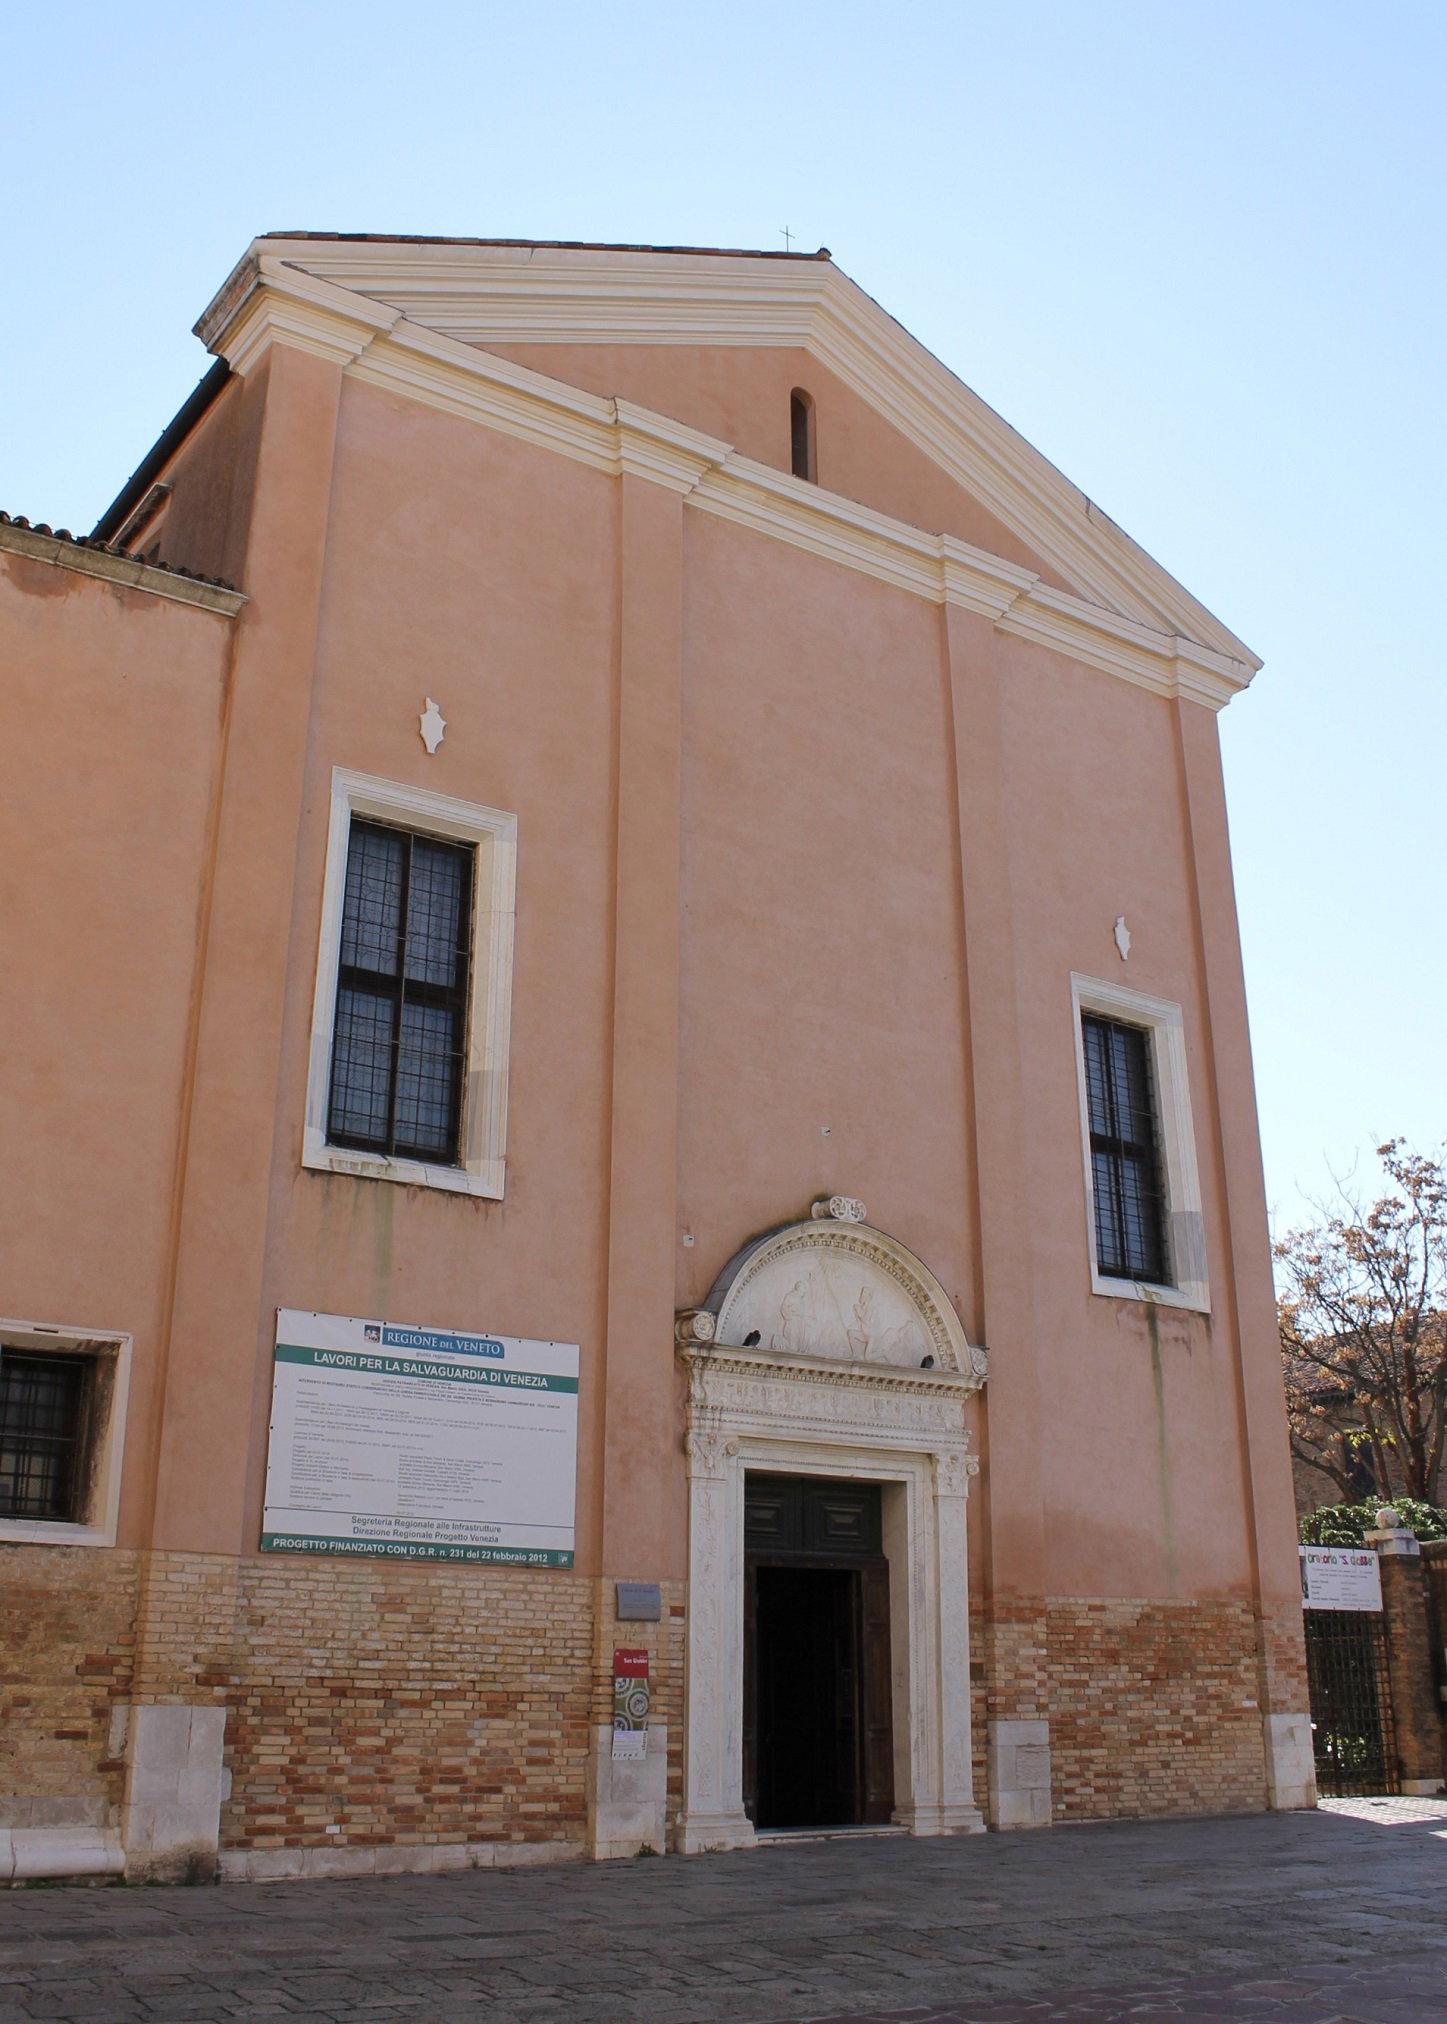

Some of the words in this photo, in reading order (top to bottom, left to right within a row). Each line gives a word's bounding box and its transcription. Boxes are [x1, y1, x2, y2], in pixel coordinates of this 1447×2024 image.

[386, 1332, 438, 1348] REGIONE
[456, 1340, 500, 1355] VENETO
[314, 1351, 356, 1366] LAVORI
[359, 1358, 382, 1369] PER
[385, 1361, 400, 1372] LA
[402, 1362, 488, 1381] SALVAGUARDIA
[490, 1372, 500, 1383] DI
[503, 1373, 548, 1388] VENEZIA
[351, 1515, 392, 1527] Segreteria
[394, 1518, 434, 1530] Regionale
[436, 1521, 450, 1530] alle
[452, 1522, 501, 1533] Infrastrutture
[352, 1526, 391, 1536] Direzione
[392, 1529, 433, 1539] Regionale
[434, 1531, 468, 1543] Progetto
[470, 1534, 499, 1543] Venezia
[273, 1537, 327, 1550] PROGETTO
[329, 1541, 385, 1553] FINANZIATO
[387, 1544, 407, 1554] CON
[409, 1545, 438, 1557] D.G.R.
[449, 1548, 464, 1559] 231
[466, 1549, 480, 1559] del
[481, 1550, 492, 1560] 22
[492, 1550, 527, 1562] febbraio
[528, 1552, 548, 1563] 2012
